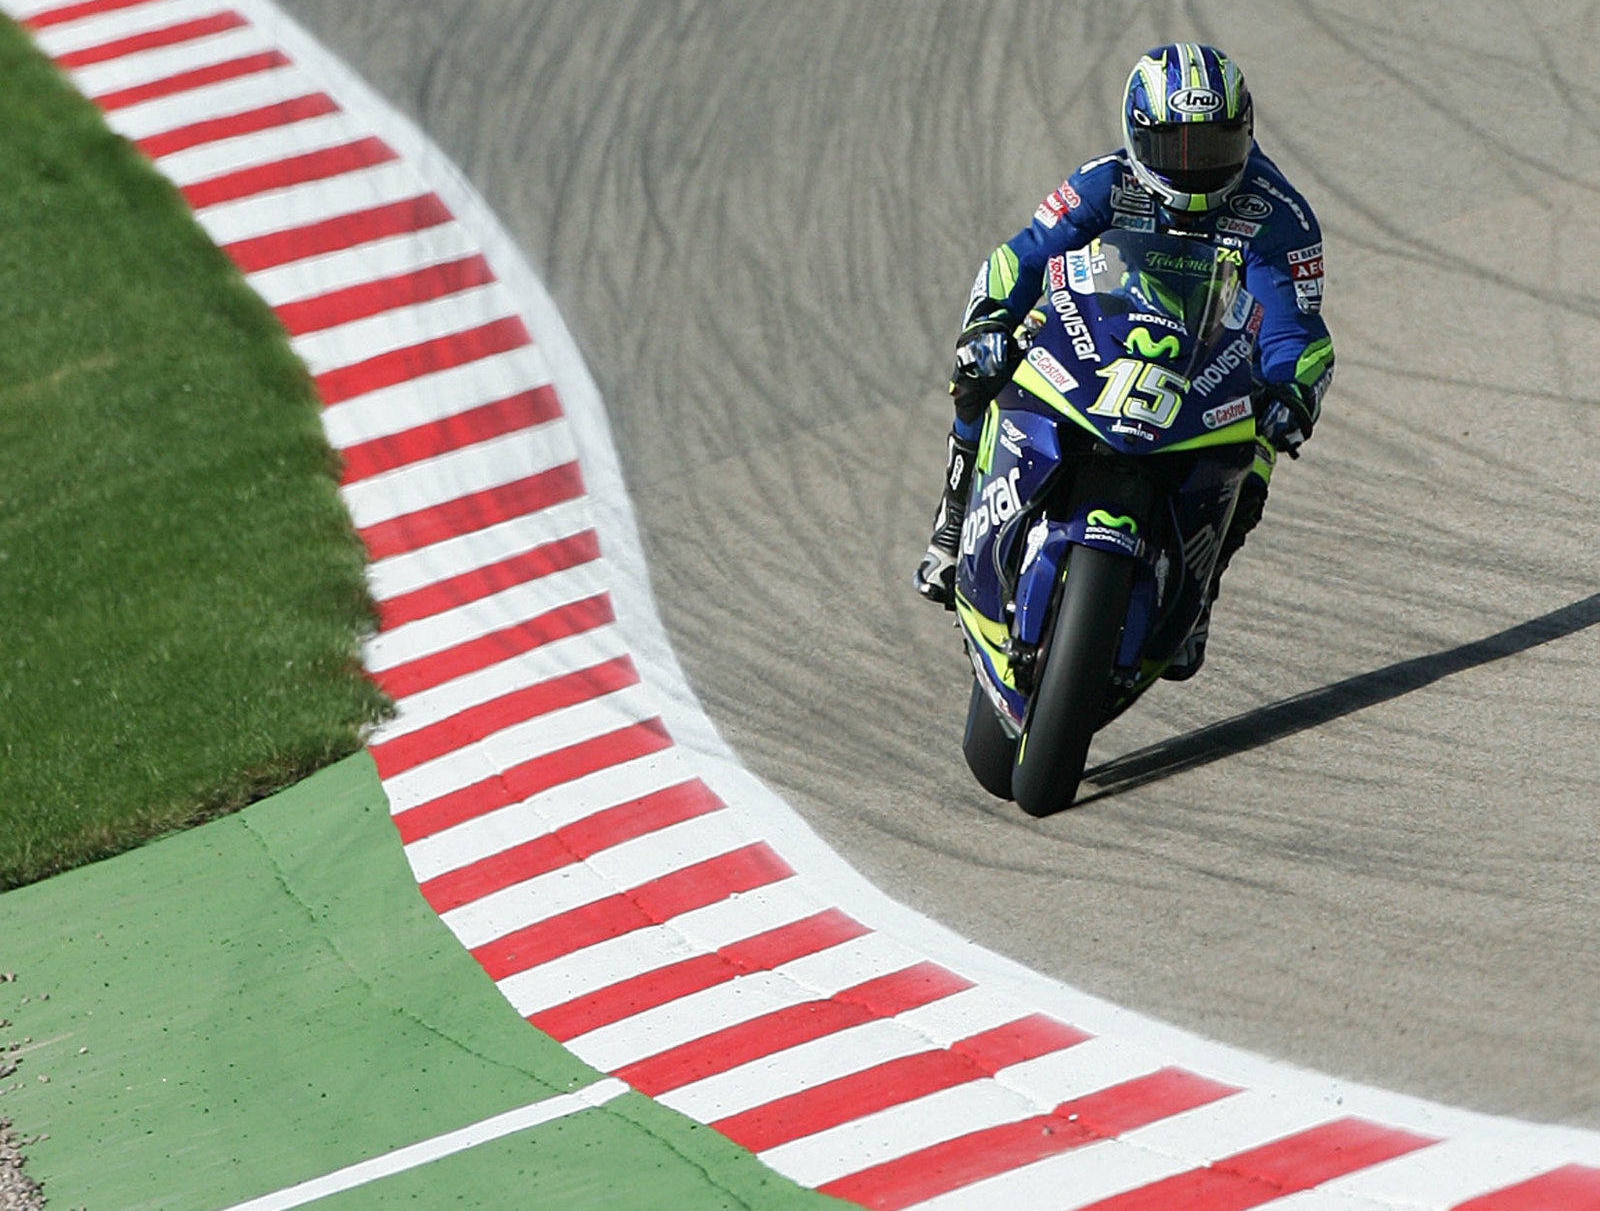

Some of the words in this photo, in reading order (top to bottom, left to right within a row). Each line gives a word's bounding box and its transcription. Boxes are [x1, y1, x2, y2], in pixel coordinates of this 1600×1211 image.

[1173, 91, 1217, 107] Arai
[1217, 247, 1244, 266] 74
[1128, 312, 1188, 336] HONDA
[1036, 353, 1070, 388] Castrol
[1086, 357, 1191, 429] 15
[1215, 399, 1248, 422] Castrol
